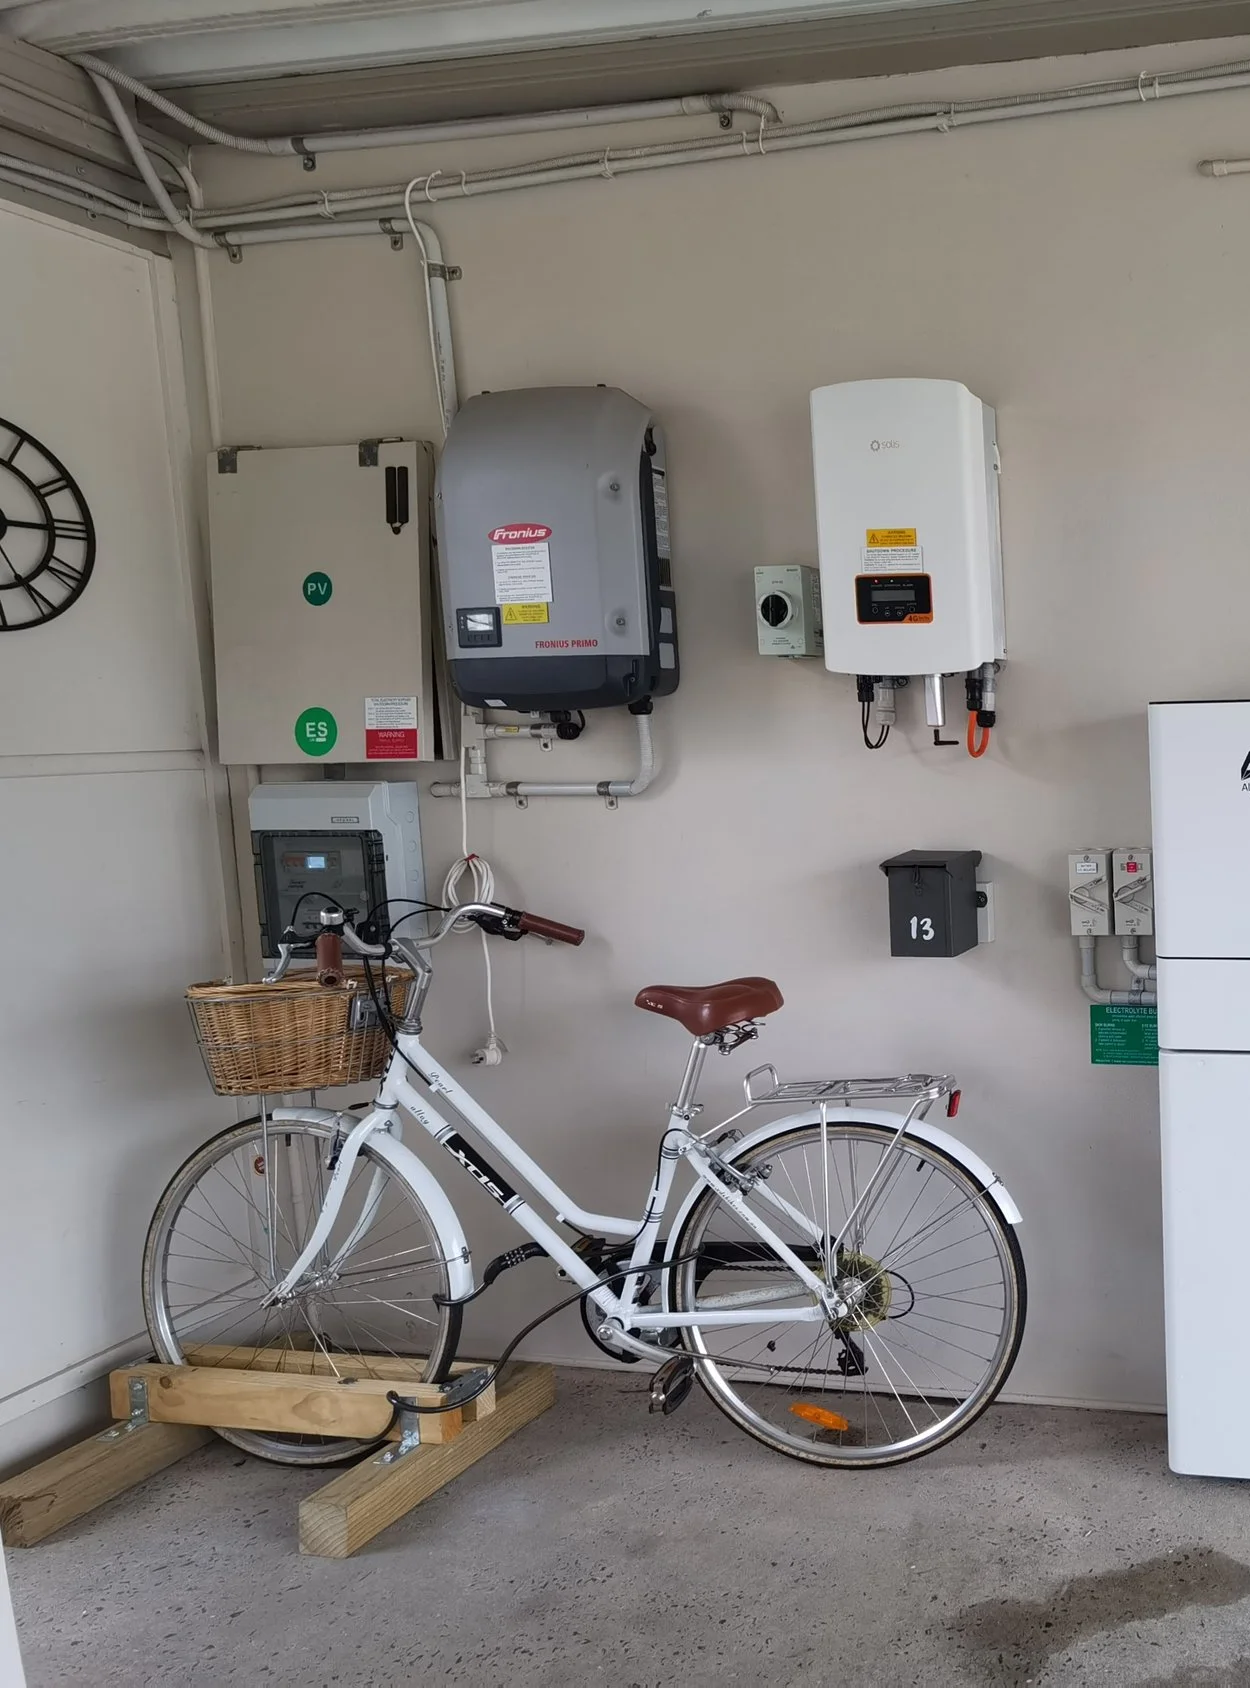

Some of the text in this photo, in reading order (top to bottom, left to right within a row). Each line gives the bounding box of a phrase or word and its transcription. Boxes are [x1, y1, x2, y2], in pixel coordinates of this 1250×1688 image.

[493, 527, 547, 541] Fronius
[307, 582, 328, 595] PV
[535, 639, 598, 649] FRONIUS PRIMO
[305, 721, 328, 738] ES
[910, 916, 935, 940] 13
[1105, 1006, 1148, 1014] ELECTROLYTE
[428, 1071, 453, 1094] Pearl
